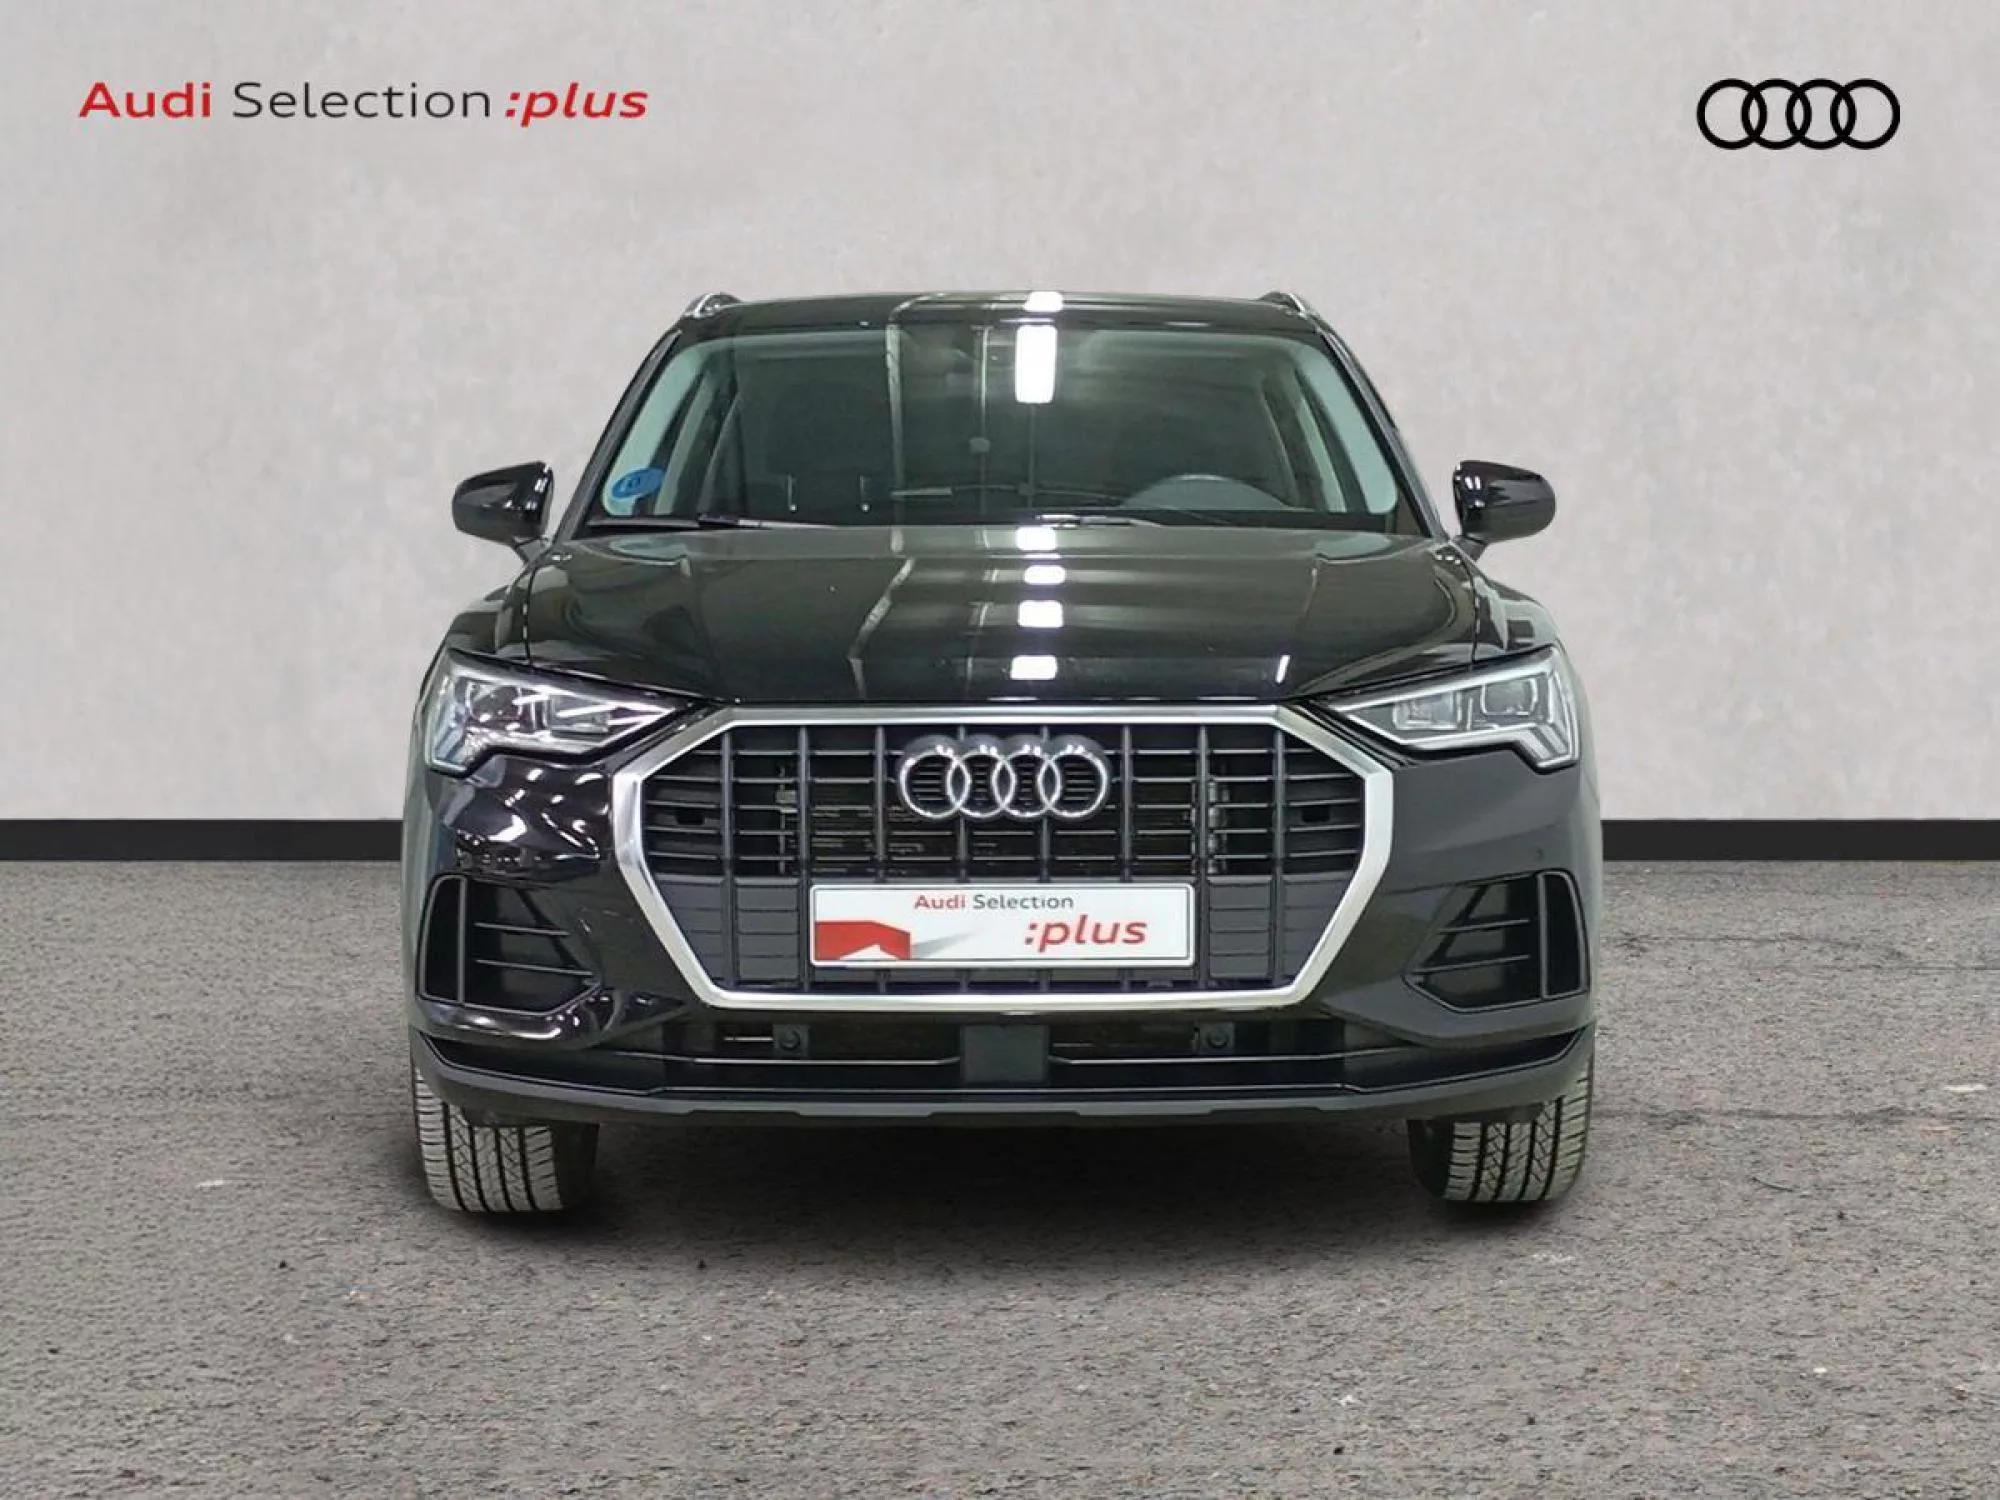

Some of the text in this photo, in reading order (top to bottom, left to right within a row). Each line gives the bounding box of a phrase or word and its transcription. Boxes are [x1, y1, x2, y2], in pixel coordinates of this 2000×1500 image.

[914, 894, 1074, 910] Audi Selection
[1024, 914, 1148, 952] :plus
